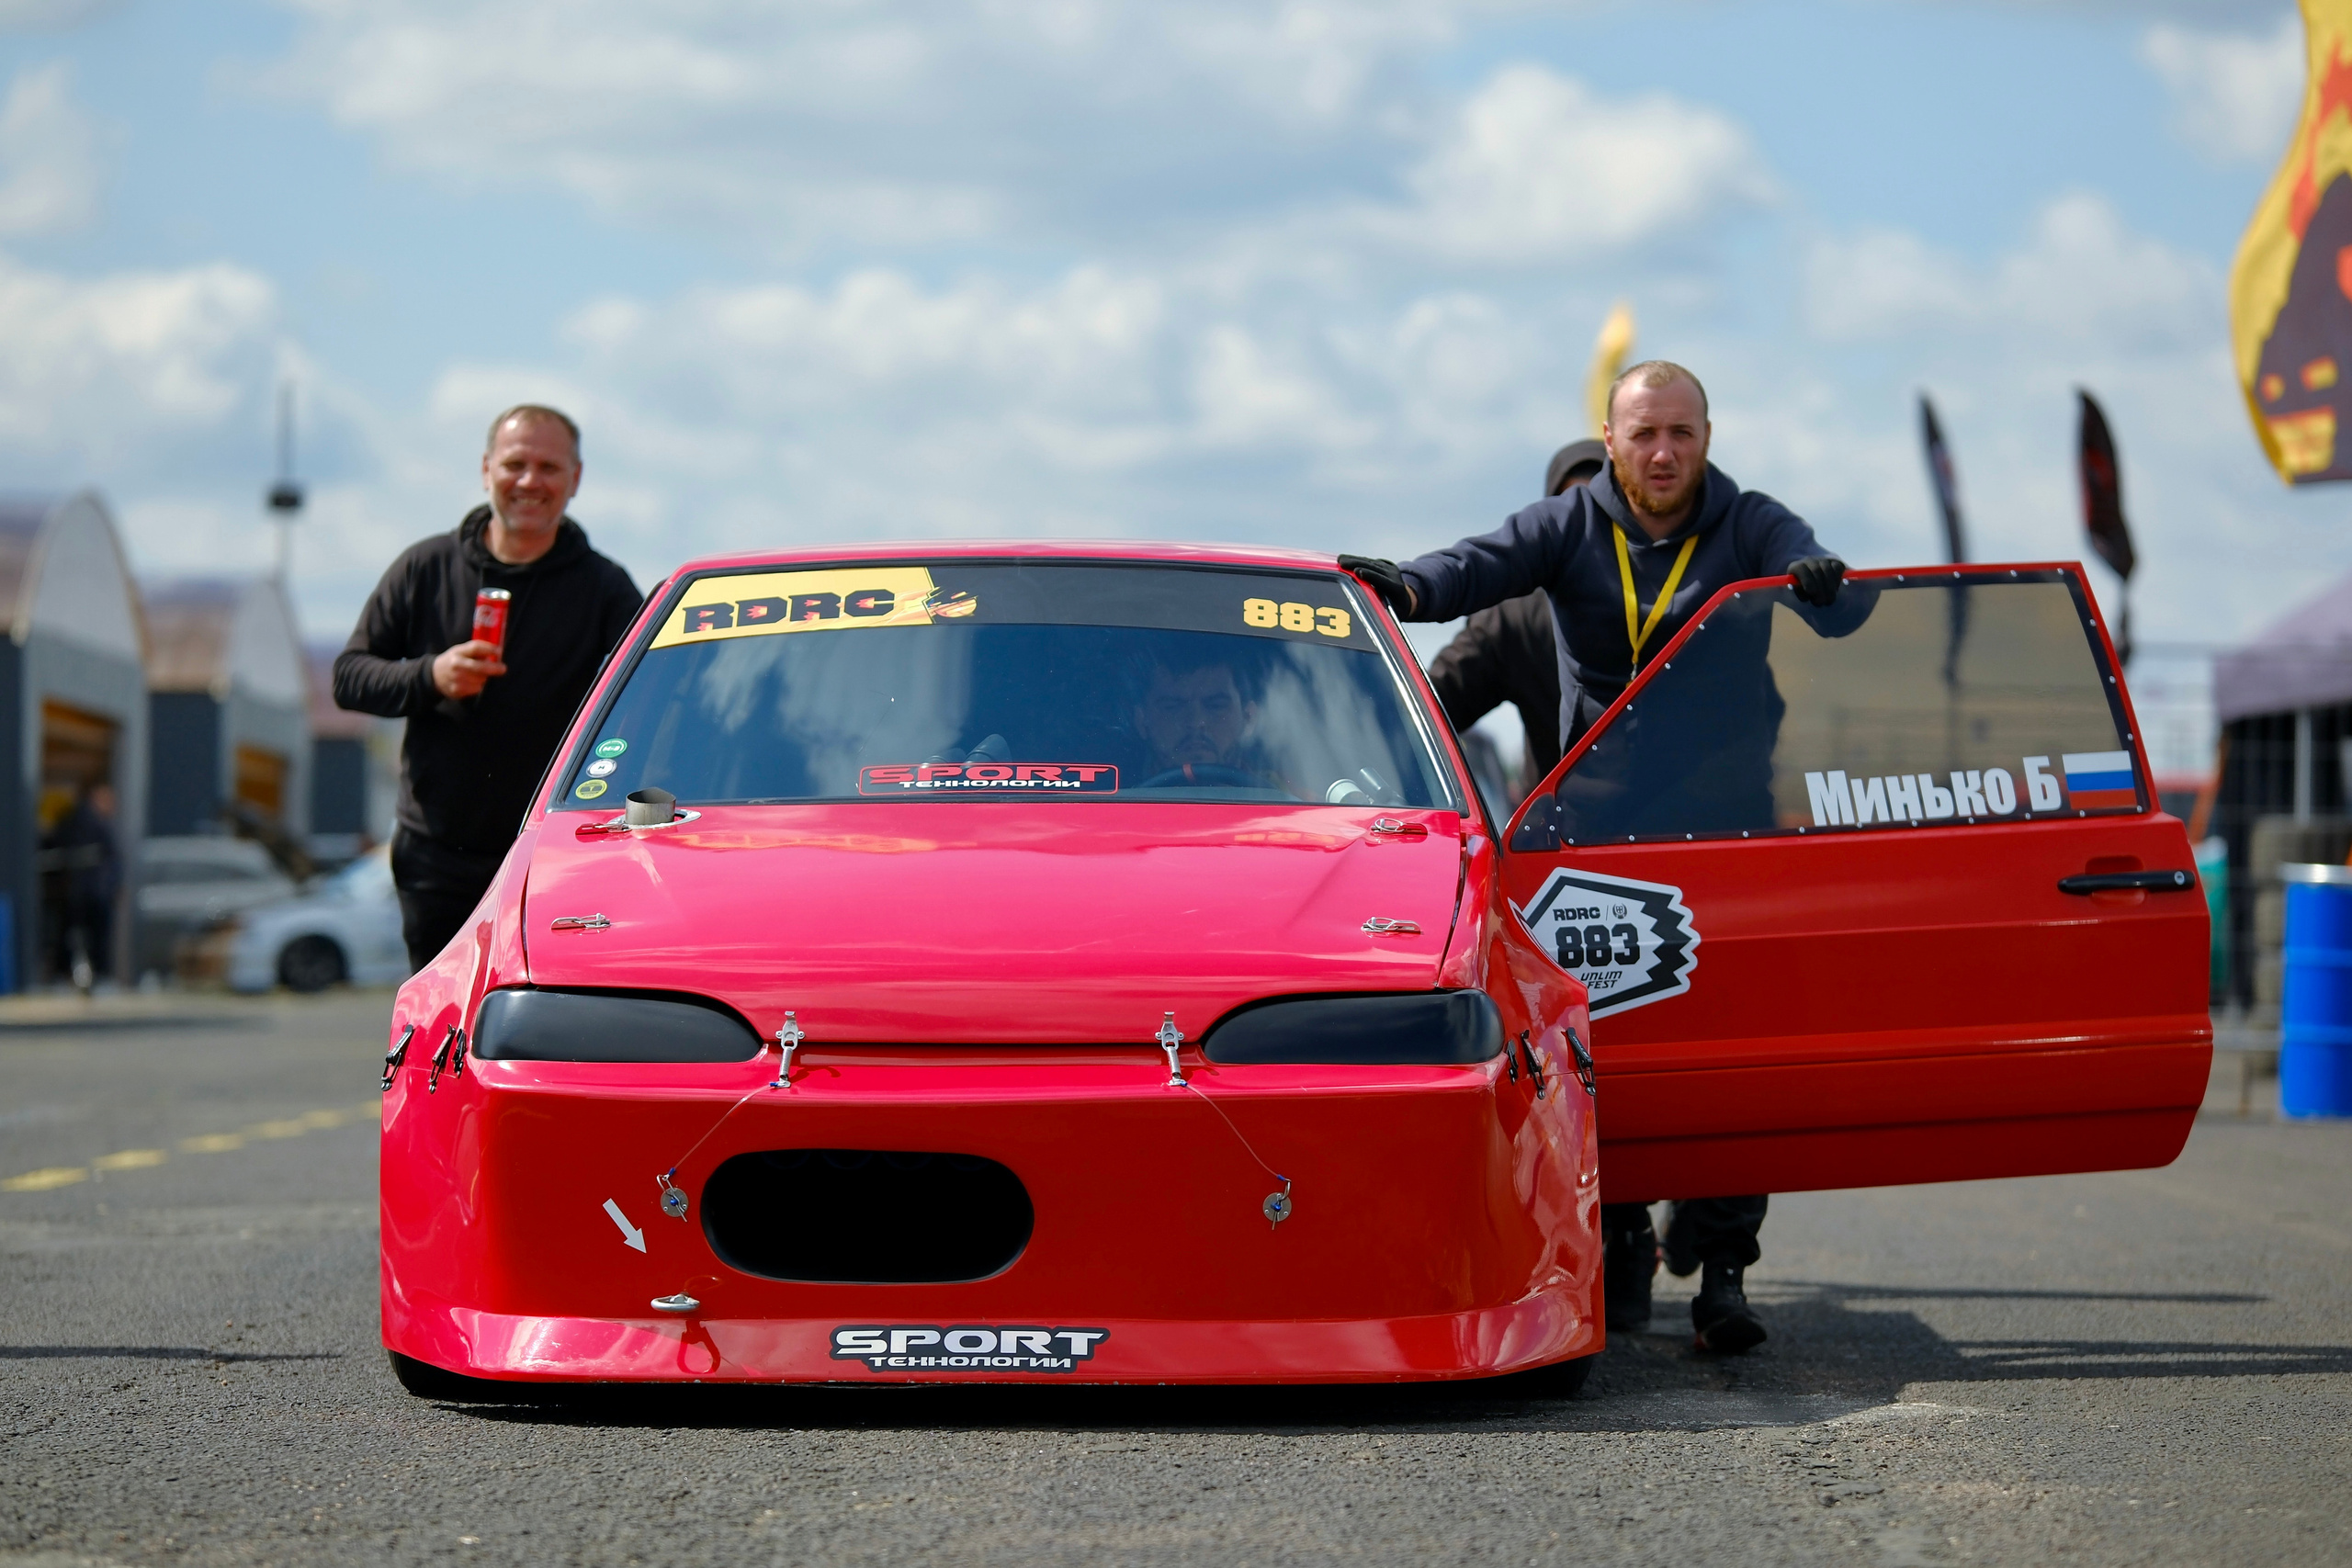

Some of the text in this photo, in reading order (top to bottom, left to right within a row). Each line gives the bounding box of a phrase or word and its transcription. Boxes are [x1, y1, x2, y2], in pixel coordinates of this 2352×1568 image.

[683, 589, 895, 634] RDRC
[1243, 597, 1351, 638] 883
[868, 765, 1110, 784] SPORT
[1804, 755, 2062, 827] Минько Б
[1553, 907, 1601, 921] RDRC
[1555, 922, 1641, 969] 883
[1580, 970, 1623, 981] UNLIM
[1587, 979, 1618, 989] FEST
[835, 1329, 1104, 1356] SPORT
